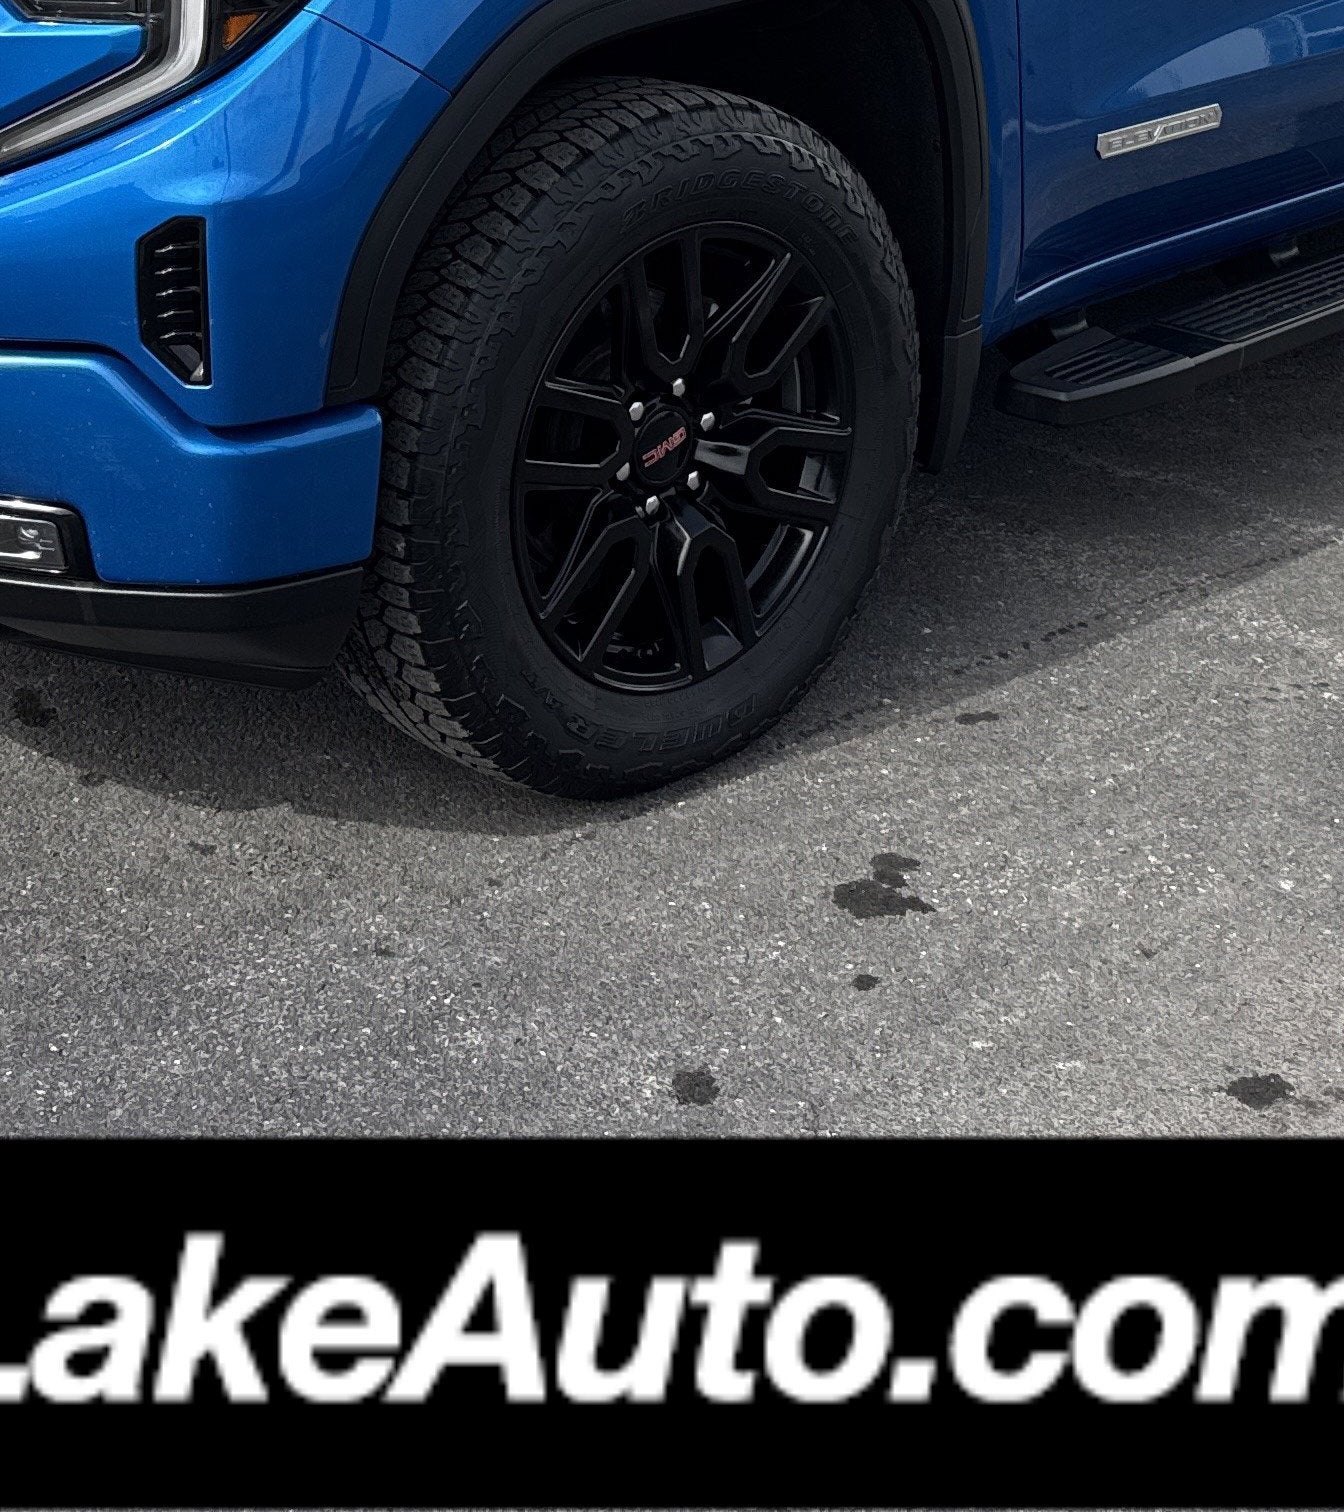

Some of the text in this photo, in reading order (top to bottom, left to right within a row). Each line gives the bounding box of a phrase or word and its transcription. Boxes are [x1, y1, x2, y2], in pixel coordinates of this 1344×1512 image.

[620, 168, 860, 245] BRIDGESTONE
[642, 426, 688, 468] GMC
[565, 693, 758, 752] DUELER
